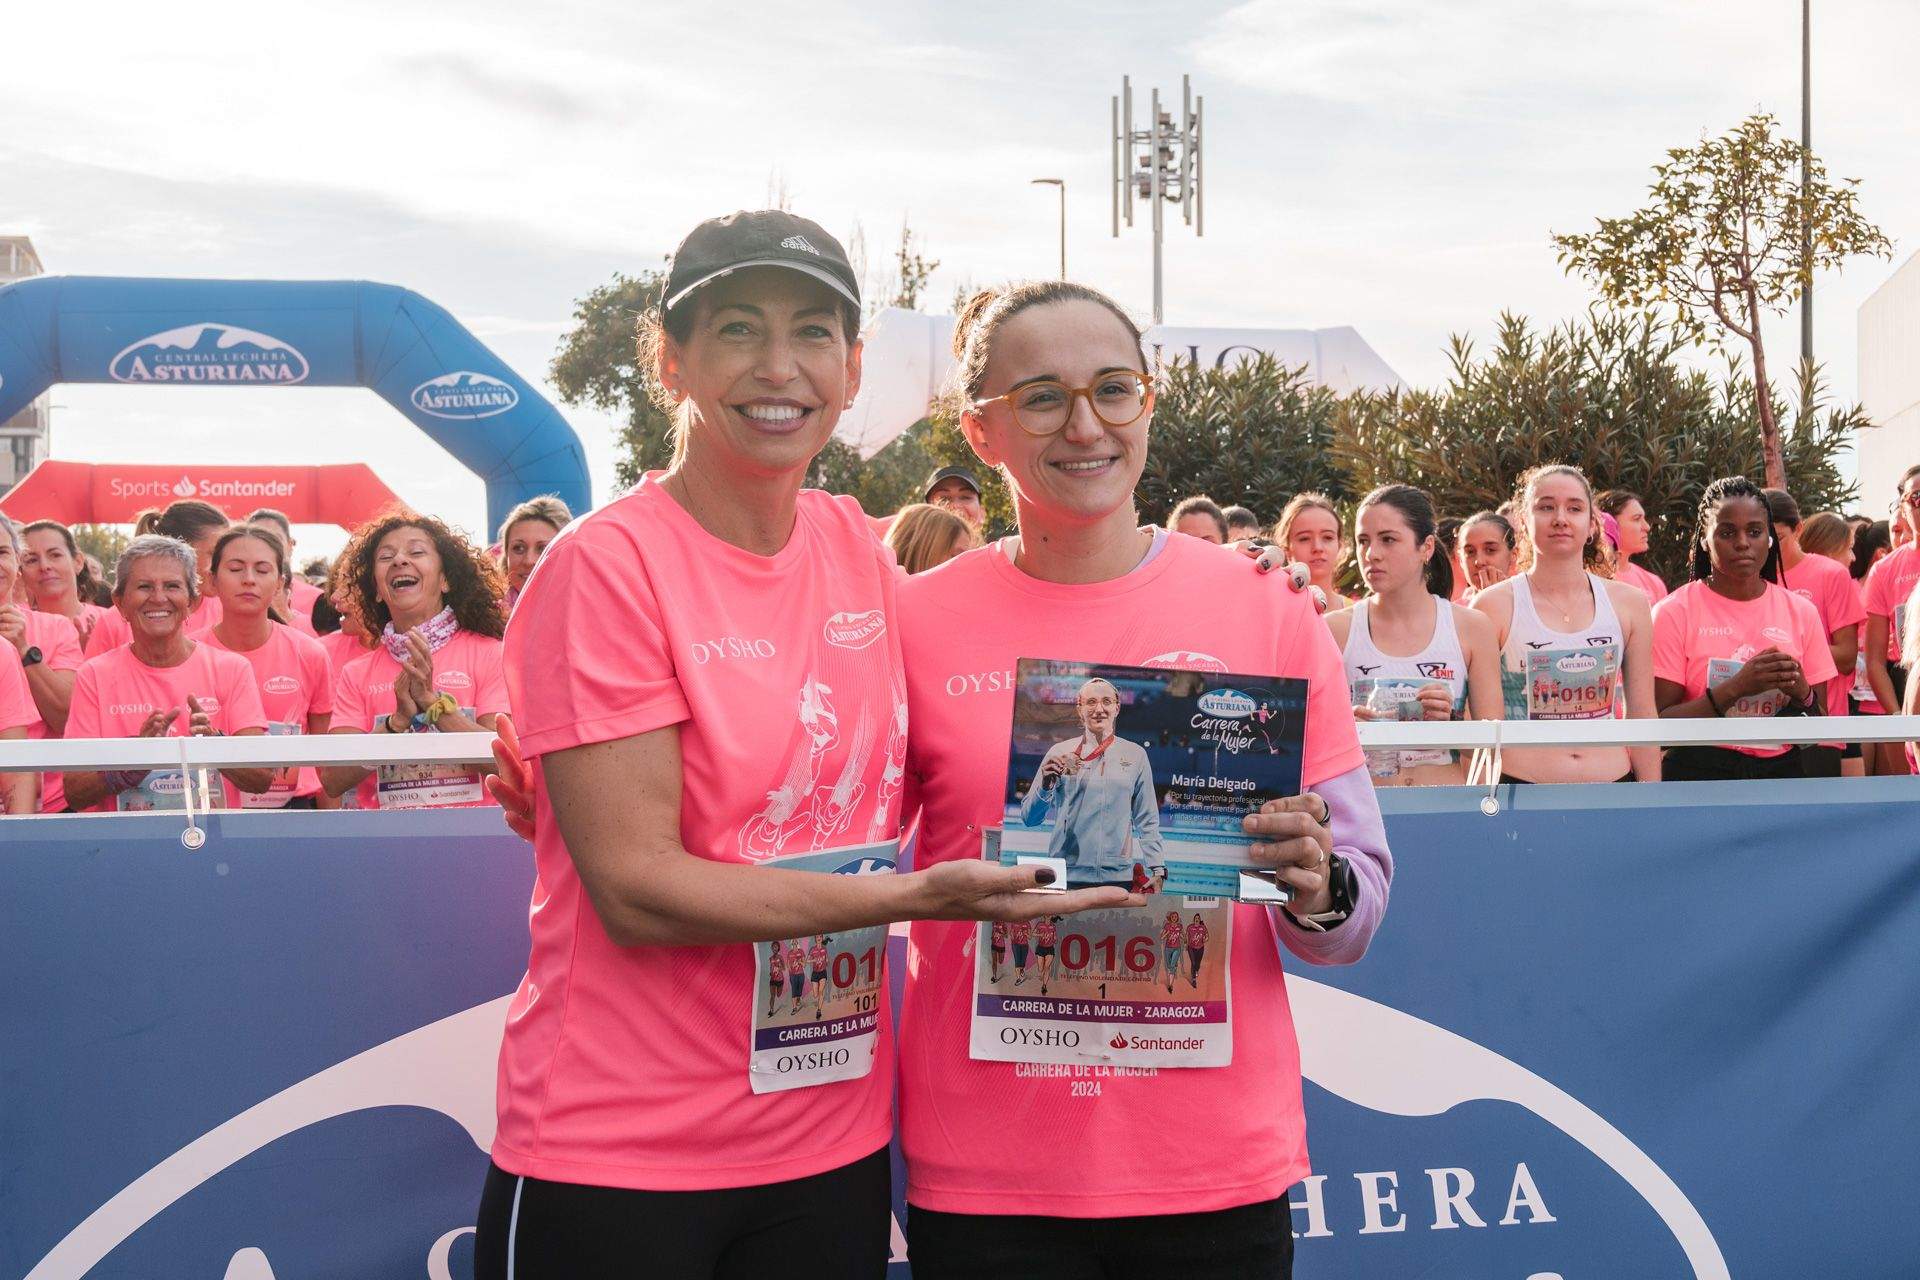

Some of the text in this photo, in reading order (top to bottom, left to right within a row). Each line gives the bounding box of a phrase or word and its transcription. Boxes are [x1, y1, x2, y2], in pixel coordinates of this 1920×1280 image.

[781, 238, 820, 256] adidas
[154, 352, 287, 363] CENTRAL LECHERA
[128, 356, 295, 381] ASTURIANA
[421, 390, 512, 408] ASTURIANA
[110, 478, 296, 499] Sports Santander
[691, 637, 776, 665] OYSHO
[946, 670, 1017, 696] OYSH
[1561, 686, 1596, 702] 016
[110, 703, 153, 714] OYSHO
[1201, 697, 1252, 712] ASTURIANA
[1737, 699, 1773, 715] 016
[1190, 713, 1240, 731] Carrera
[1201, 729, 1257, 755] de la Mujer
[1171, 774, 1256, 792] María Delgado
[1171, 791, 1183, 800] Por
[1193, 793, 1228, 803] trayectoria
[1228, 795, 1265, 805] profesional
[1170, 803, 1181, 811] por
[1203, 804, 1235, 813] referente
[1060, 933, 1156, 974] 016
[1098, 982, 1106, 999] 1
[1003, 1000, 1206, 1018] CARRERA DE LA MUJER ZARAGOZA
[779, 1011, 880, 1042] CARRERA DE LA MUJE
[1000, 1027, 1205, 1051] OYSHO Santander
[777, 1048, 850, 1073] OYSHO
[1015, 1062, 1072, 1077] CARRERA
[1075, 1064, 1091, 1077] DE
[1095, 1065, 1111, 1077] LA
[1071, 1080, 1102, 1097] 2024
